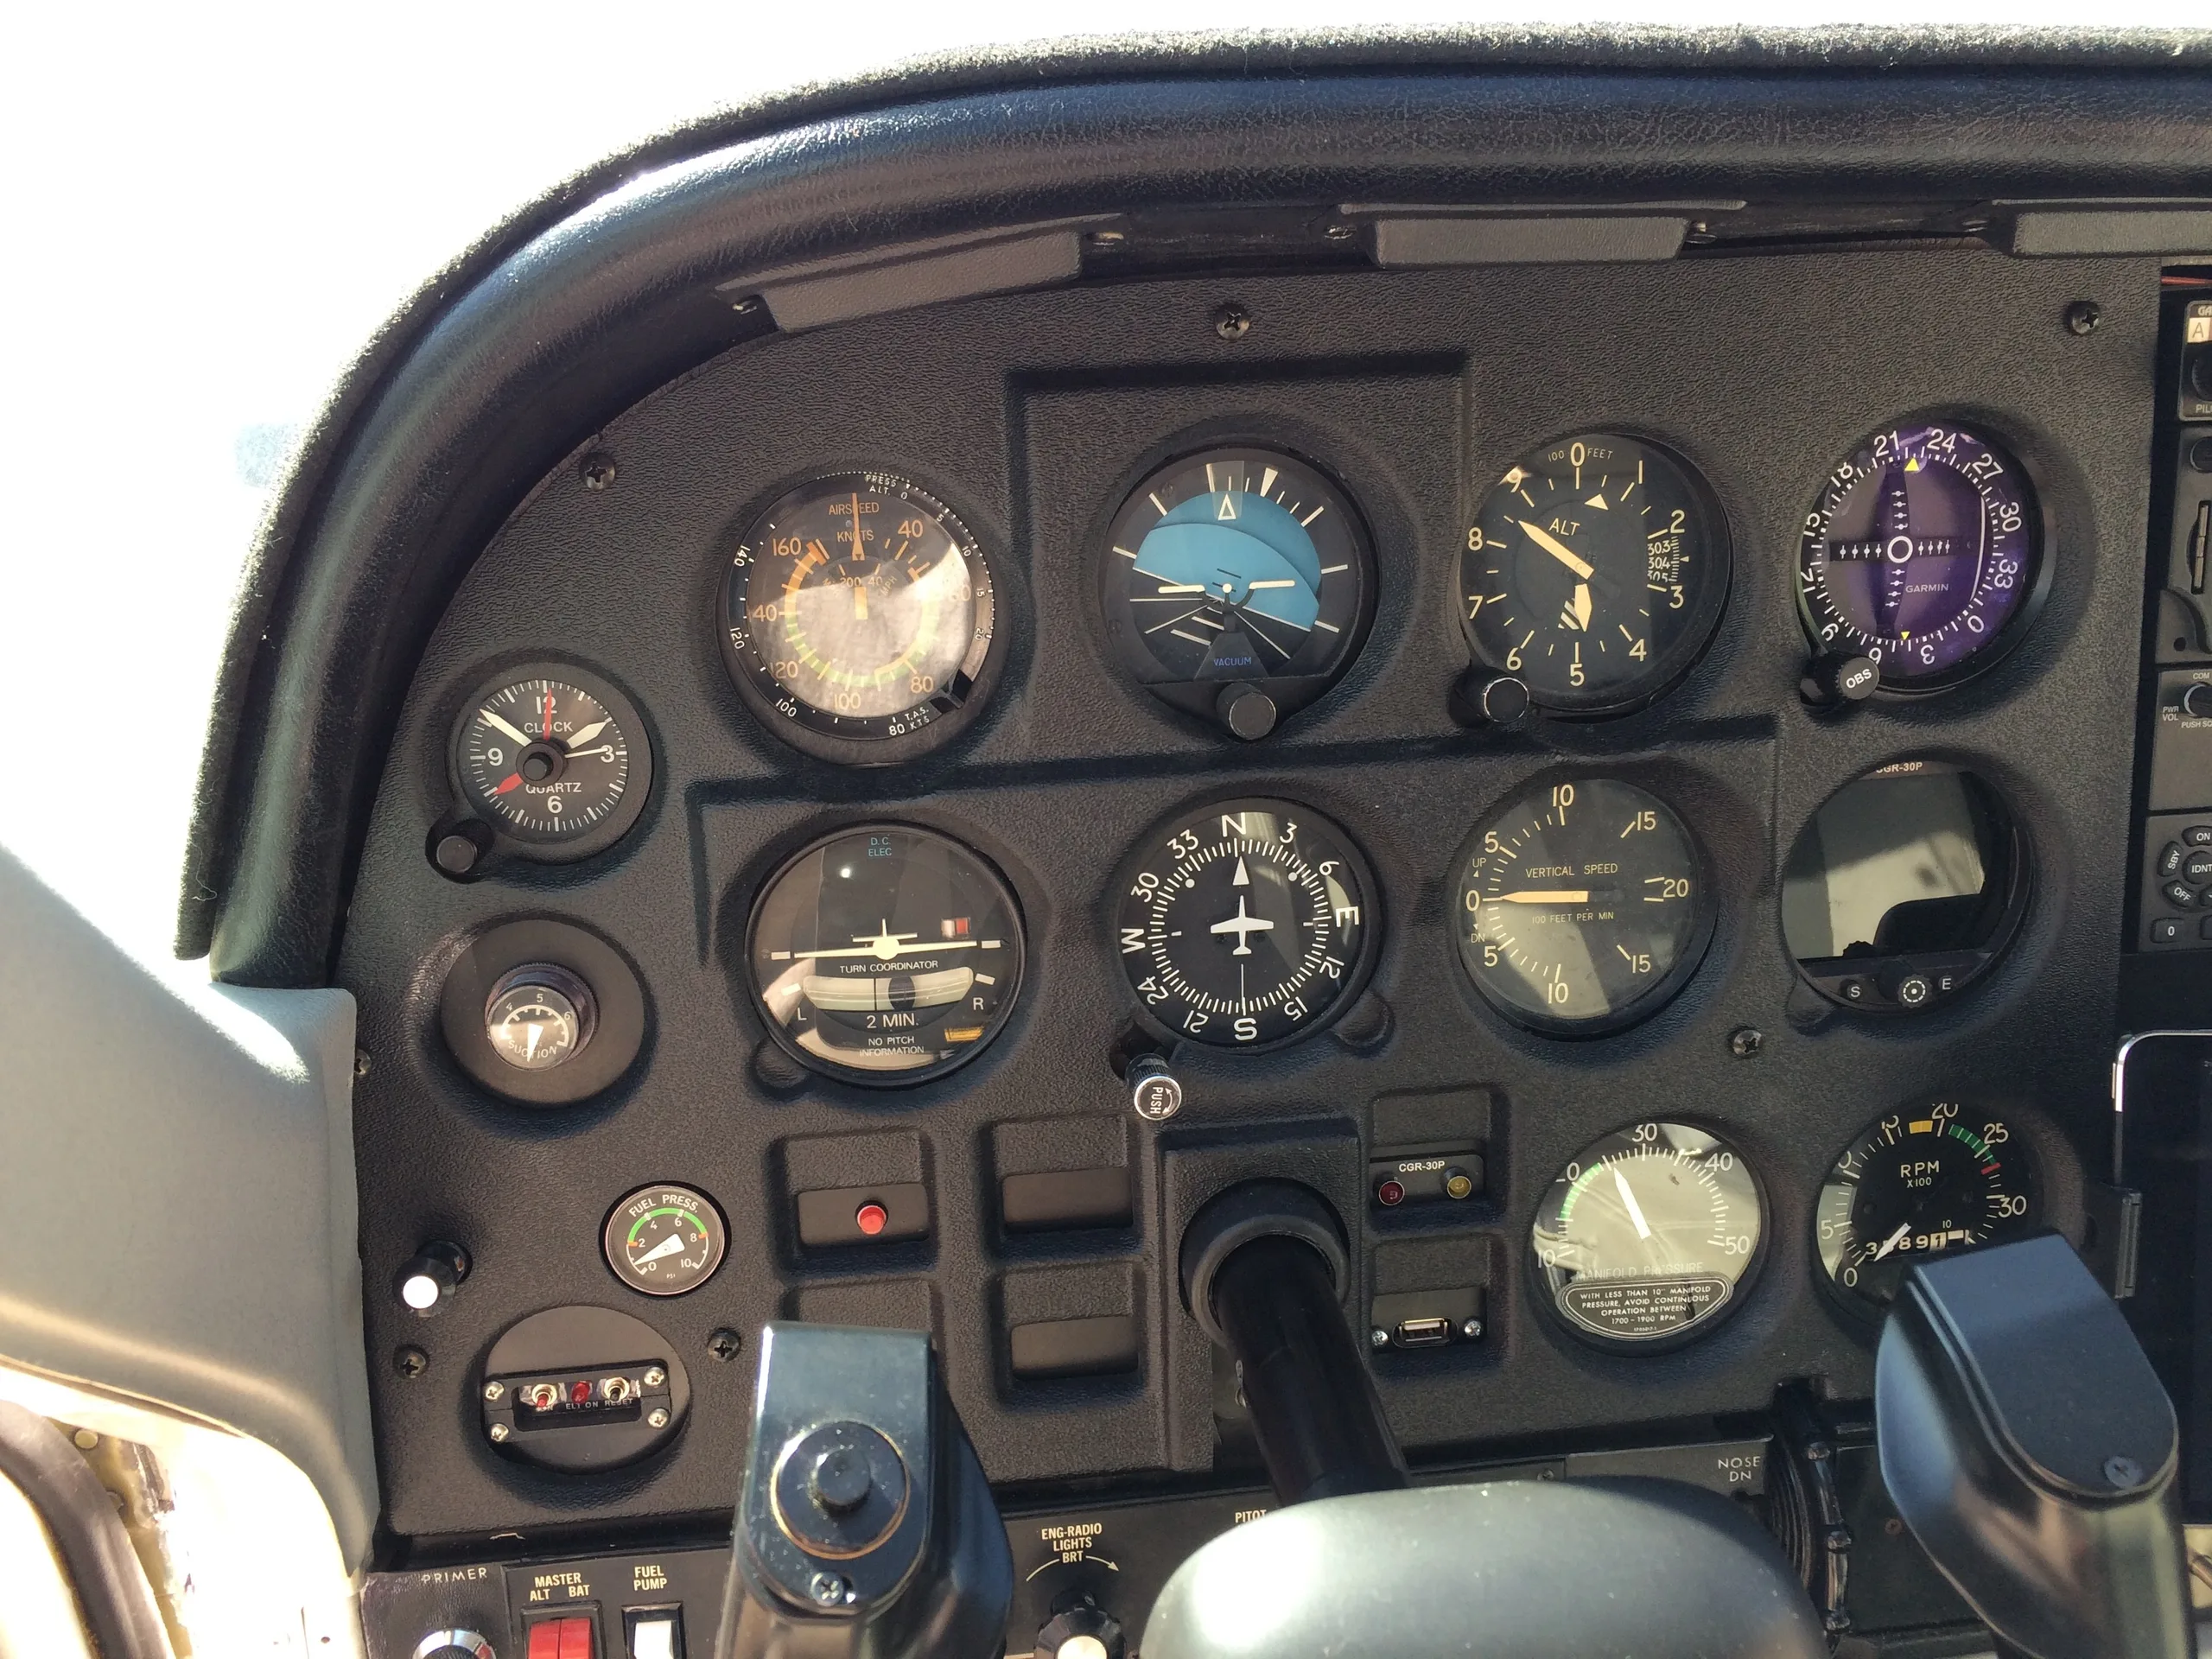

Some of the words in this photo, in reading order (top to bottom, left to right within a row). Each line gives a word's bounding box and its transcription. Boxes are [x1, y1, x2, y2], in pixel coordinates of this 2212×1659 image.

[2192, 322, 2204, 339] A
[1873, 430, 1900, 457] 21
[1926, 429, 1957, 454] 24
[1548, 450, 1565, 462] 100
[1586, 448, 1613, 460] FEET
[1570, 442, 1586, 467] 0
[1972, 453, 2004, 480] 27
[866, 474, 897, 486] PRESS
[1506, 469, 1522, 493] 9
[869, 486, 890, 496] ALT.
[829, 502, 880, 515] AIRSEED
[1999, 501, 2021, 532] 30
[898, 520, 923, 538] 40
[1548, 518, 1580, 536] ALT
[1670, 510, 1685, 533] 2
[772, 537, 802, 556] 160
[1468, 526, 1483, 551] 8
[734, 544, 751, 567] 140
[1647, 540, 1671, 556] 30.3
[1648, 556, 1671, 569] 30.4
[840, 576, 861, 588] 200
[1994, 558, 2018, 589] 33
[1669, 585, 1684, 608] 3
[1905, 583, 1949, 594] GARMIN
[1468, 595, 1483, 619] 7
[1967, 614, 1984, 633] 0
[729, 627, 745, 650] 120
[1506, 647, 1522, 671] 6
[1629, 639, 1646, 661] 4
[1920, 644, 1935, 665] 3
[1213, 656, 1252, 666] VACUUM
[1570, 663, 1585, 686] 5
[1846, 669, 1872, 689] OBS
[910, 676, 934, 694] 80
[536, 696, 557, 715] 12
[776, 698, 797, 717] 100
[834, 692, 861, 710] 100
[910, 715, 930, 730] KTS
[2162, 713, 2178, 721] VOL
[524, 721, 573, 734] CLOCK
[888, 723, 906, 736] 80
[487, 748, 503, 766] 9
[601, 745, 614, 763] 3
[525, 782, 582, 794] QUARTZ
[1552, 784, 1574, 807] 10
[547, 795, 563, 813] 6
[1221, 811, 1247, 837] N
[1637, 811, 1656, 830] 15
[1280, 822, 1297, 844] 3
[2196, 832, 2210, 841] ON
[1166, 829, 1199, 860] 33
[1484, 831, 1499, 854] 5
[868, 848, 892, 856] ELEC
[2168, 850, 2180, 869] SBY
[1319, 861, 1339, 875] 6
[1471, 857, 1487, 868] UP
[1525, 866, 1574, 879] VERTICAL
[1584, 863, 1618, 874] SPEED
[2191, 864, 2212, 873] IDNT
[1130, 872, 1160, 903] 30
[1662, 879, 1688, 898] 20
[2174, 887, 2191, 901] OFF
[1465, 890, 1479, 912] 0
[1335, 906, 1359, 927] E
[1531, 915, 1546, 925] 100
[1549, 913, 1572, 923] FEET
[1576, 912, 1593, 922] PER
[1599, 911, 1614, 920] MIN
[1471, 933, 1485, 944] DN
[2168, 925, 2175, 936] 0
[1121, 928, 1147, 954] W
[1484, 945, 1497, 967] 5
[1632, 954, 1651, 974] 15
[840, 964, 866, 974] TURN
[869, 960, 938, 972] COORDINATOR
[1319, 956, 1344, 979] 12
[1137, 976, 1169, 1005] 24
[1548, 982, 1568, 1004] 10
[1851, 985, 1860, 998] S
[1942, 978, 1951, 990] E
[505, 1002, 512, 1011] 4
[537, 994, 543, 1002] 5
[973, 997, 984, 1010] R
[564, 1011, 570, 1020] 6
[797, 1007, 806, 1020] L
[1283, 996, 1308, 1021] 15
[867, 1015, 877, 1028] 2
[883, 1013, 918, 1027] MIN.
[1182, 1009, 1209, 1033] 21
[1233, 1017, 1258, 1041] S
[868, 1037, 883, 1046] NO
[887, 1036, 915, 1045] PITCH
[860, 1046, 925, 1057] INFORMATION
[1149, 1087, 1163, 1115] PUSH
[1631, 1123, 1657, 1142] 30
[1983, 1123, 2009, 1144] 25
[1399, 1160, 1445, 1173] CGR-30P
[1705, 1152, 1732, 1172] 40
[1901, 1160, 1940, 1178] RPM
[1907, 1177, 1932, 1188] X100
[629, 1198, 657, 1217] FUEL
[662, 1194, 699, 1213] PRESS.
[1999, 1195, 2027, 1218] 30
[650, 1220, 658, 1230] 4
[674, 1217, 682, 1227] 6
[1821, 1219, 1834, 1240] 5
[1942, 1219, 1952, 1229] 10
[639, 1238, 645, 1248] 2
[690, 1233, 697, 1243] 8
[1725, 1236, 1750, 1255] 50
[648, 1262, 657, 1271] 0
[680, 1258, 692, 1268] 10
[1537, 1249, 1556, 1268] 10
[1576, 1266, 1637, 1281] MANIFOLD
[1643, 1262, 1704, 1276] PRESSURE
[1843, 1268, 1858, 1287] 0
[1669, 1286, 1711, 1294] MANIFOLD
[1654, 1294, 1710, 1305] CONTINUOUS
[1600, 1307, 1646, 1317] OPERATION
[1649, 1305, 1687, 1313] BETWEEN
[1718, 1455, 1761, 1470] NOSE
[1729, 1470, 1752, 1482] DN
[1235, 1510, 1267, 1523] PITOT
[1041, 1522, 1103, 1540] ENG-RADIO
[1053, 1537, 1092, 1552] LIGHTS
[1062, 1551, 1084, 1564] BRT
[422, 1567, 488, 1584] PRIMER
[534, 1572, 582, 1589] MASTER
[634, 1566, 664, 1579] FUEL
[529, 1589, 550, 1602] ALT
[568, 1584, 590, 1598] BAT
[633, 1578, 667, 1592] PUMP
